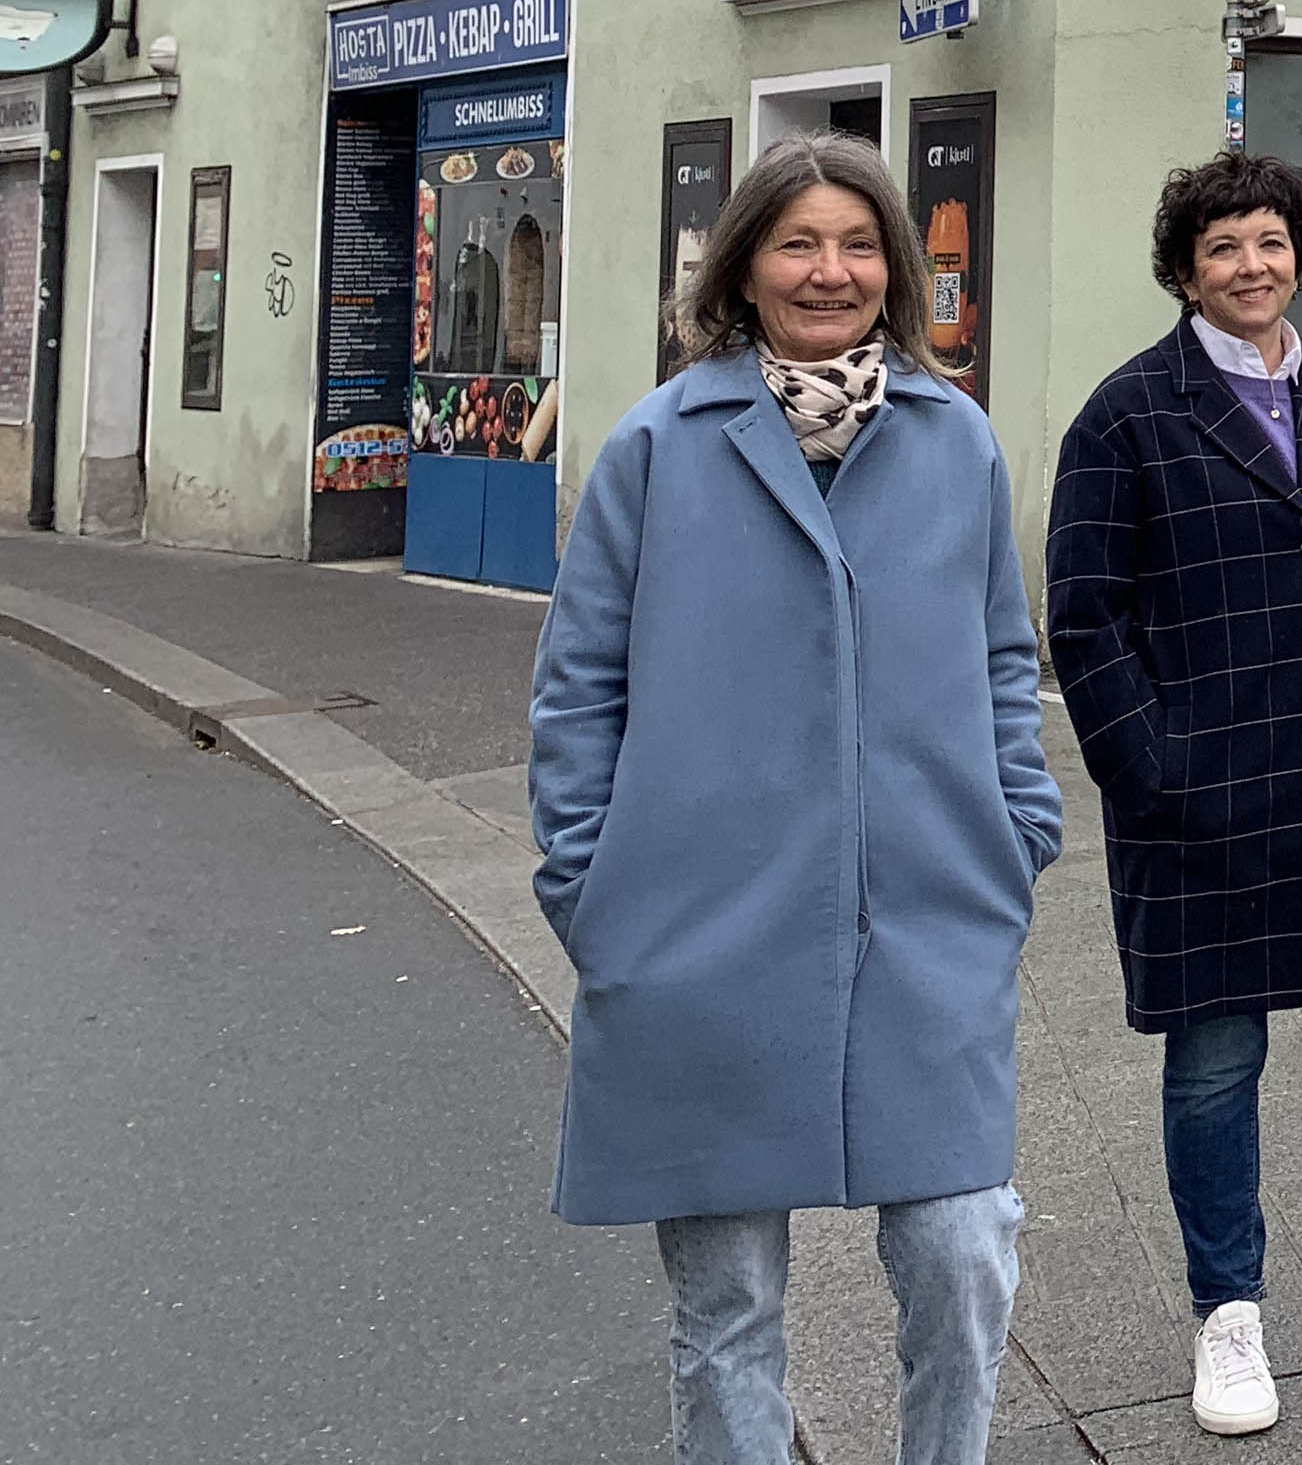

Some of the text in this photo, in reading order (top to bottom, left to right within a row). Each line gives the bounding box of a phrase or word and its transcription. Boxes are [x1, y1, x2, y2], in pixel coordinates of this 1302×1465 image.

[338, 24, 388, 64] HOSTA
[393, 15, 438, 68] PIZZA
[447, 2, 502, 60] KEBAP
[347, 63, 379, 84] Imbiss
[454, 92, 545, 127] SCHNELLIMBISS
